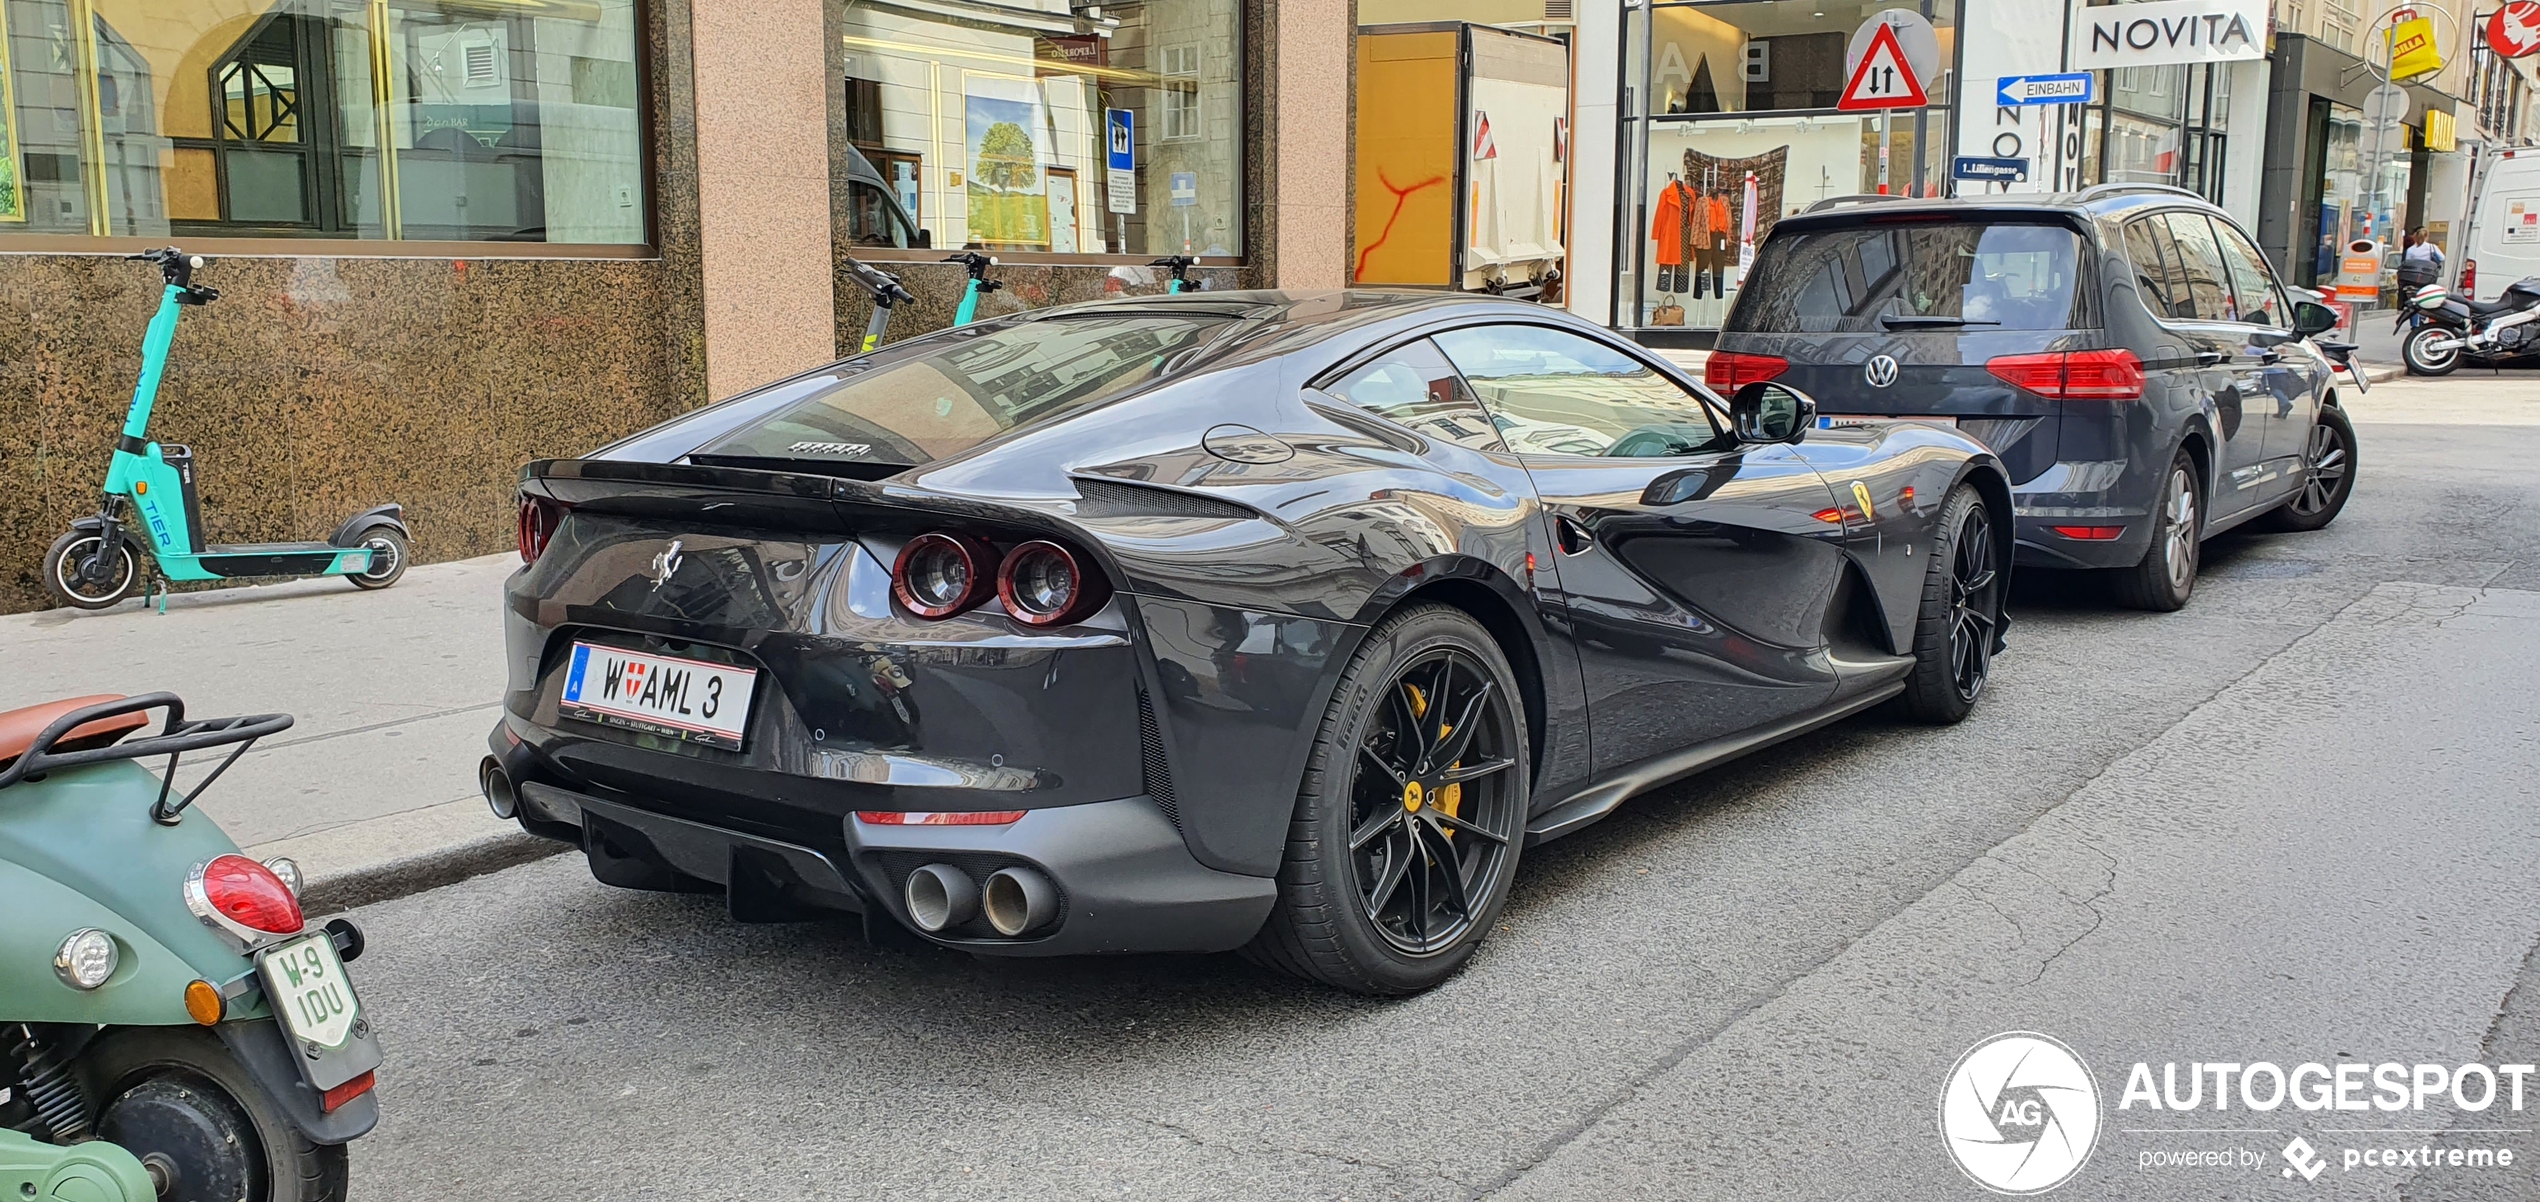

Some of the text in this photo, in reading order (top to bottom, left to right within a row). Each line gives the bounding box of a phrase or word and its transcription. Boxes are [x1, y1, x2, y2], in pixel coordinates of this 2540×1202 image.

[2092, 11, 2250, 52] NOVITA
[2027, 81, 2080, 96] EINBAHN
[183, 462, 191, 485] TIER
[146, 500, 171, 547] TIER
[570, 681, 578, 693] A
[603, 657, 723, 719] W AML 3
[630, 721, 656, 732] STUTTGART
[1336, 683, 1368, 750] PIRELLI
[279, 946, 324, 988] W-9
